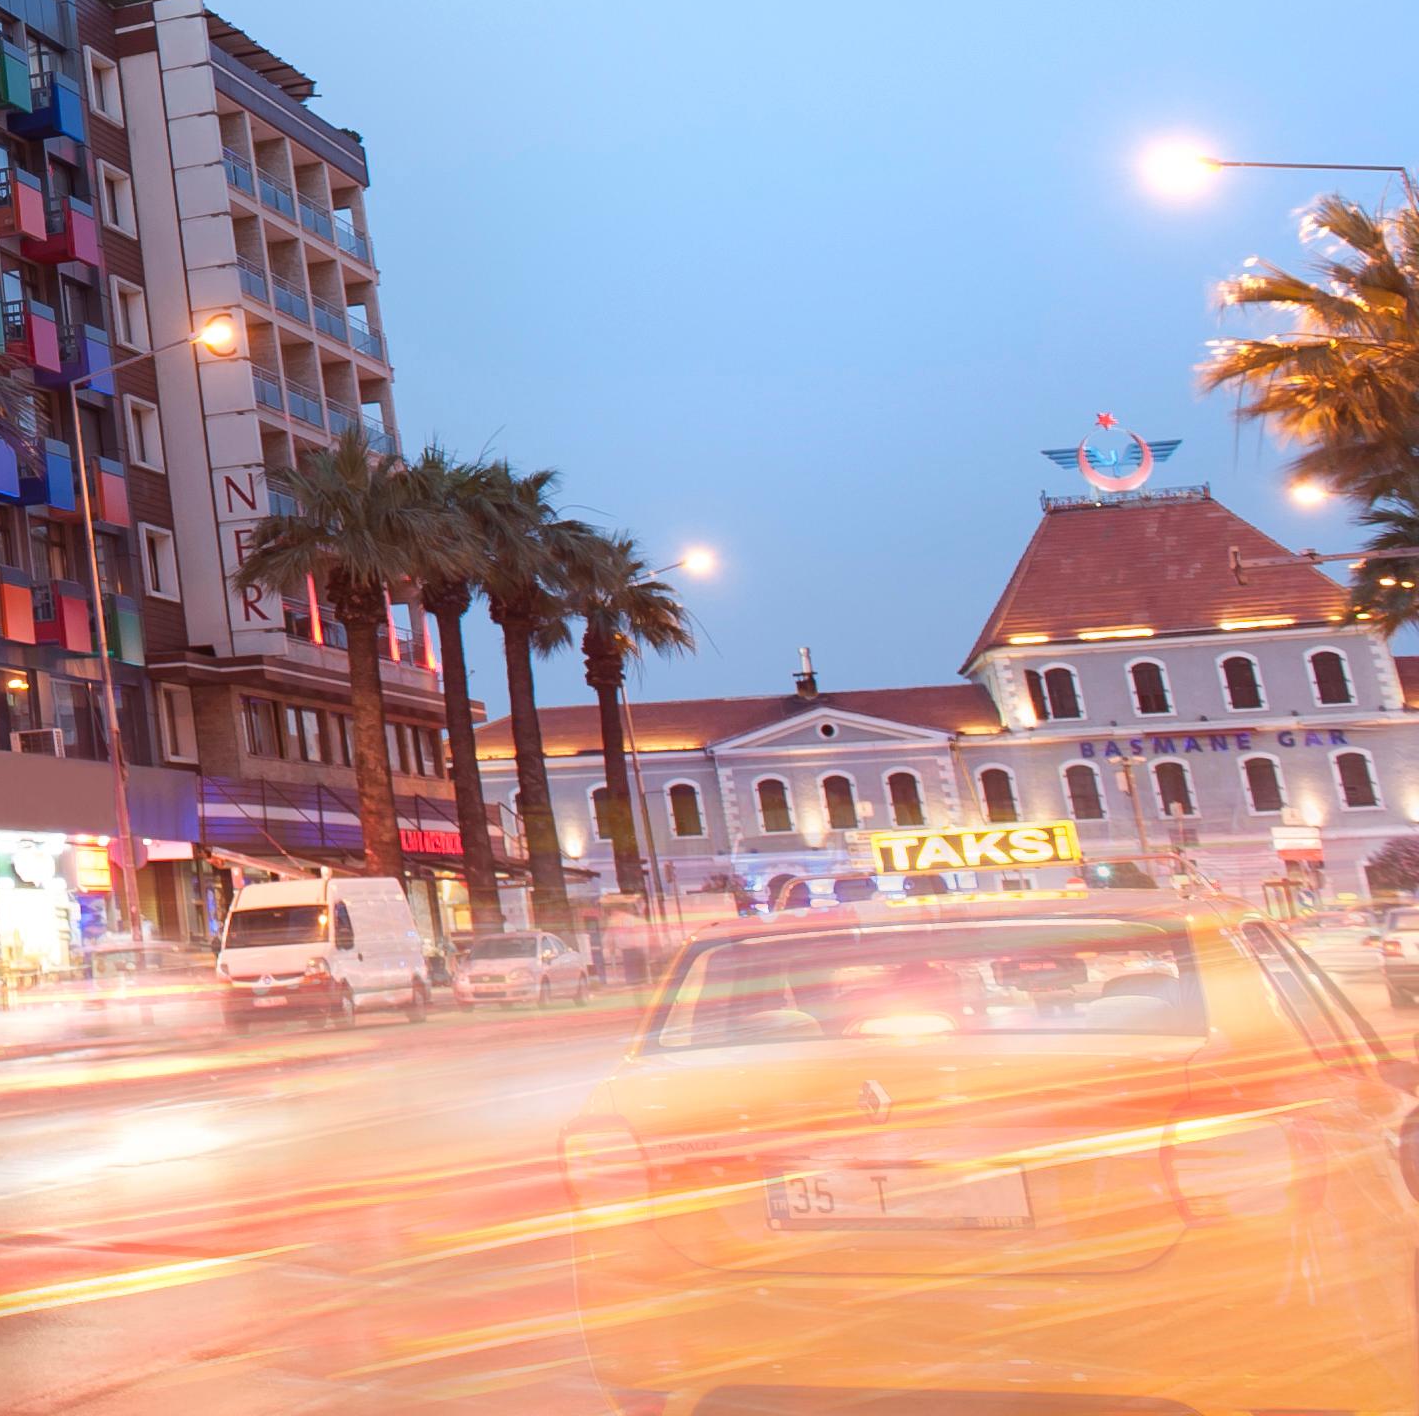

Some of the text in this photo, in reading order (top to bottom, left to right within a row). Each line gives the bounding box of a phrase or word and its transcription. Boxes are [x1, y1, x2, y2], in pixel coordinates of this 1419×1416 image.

[1078, 729, 1349, 759] BASMANE GAR
[789, 1176, 835, 1214] 35
[870, 1175, 888, 1215] T
